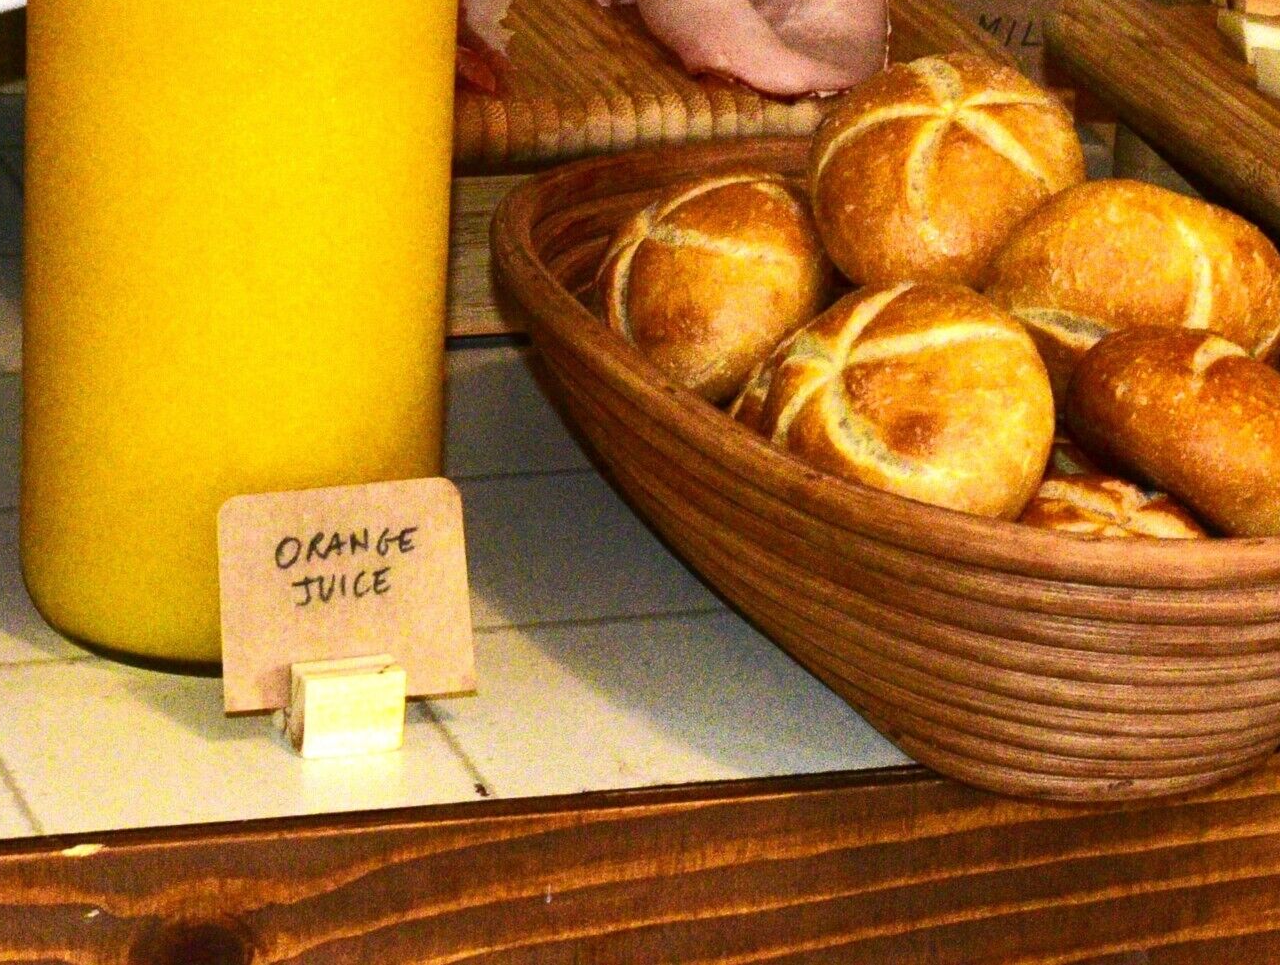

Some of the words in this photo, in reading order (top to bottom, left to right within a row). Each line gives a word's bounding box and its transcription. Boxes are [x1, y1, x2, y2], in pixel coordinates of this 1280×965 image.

[977, 11, 1045, 47] MIL
[274, 524, 419, 569] ORANGE
[291, 566, 392, 607] JUICE
